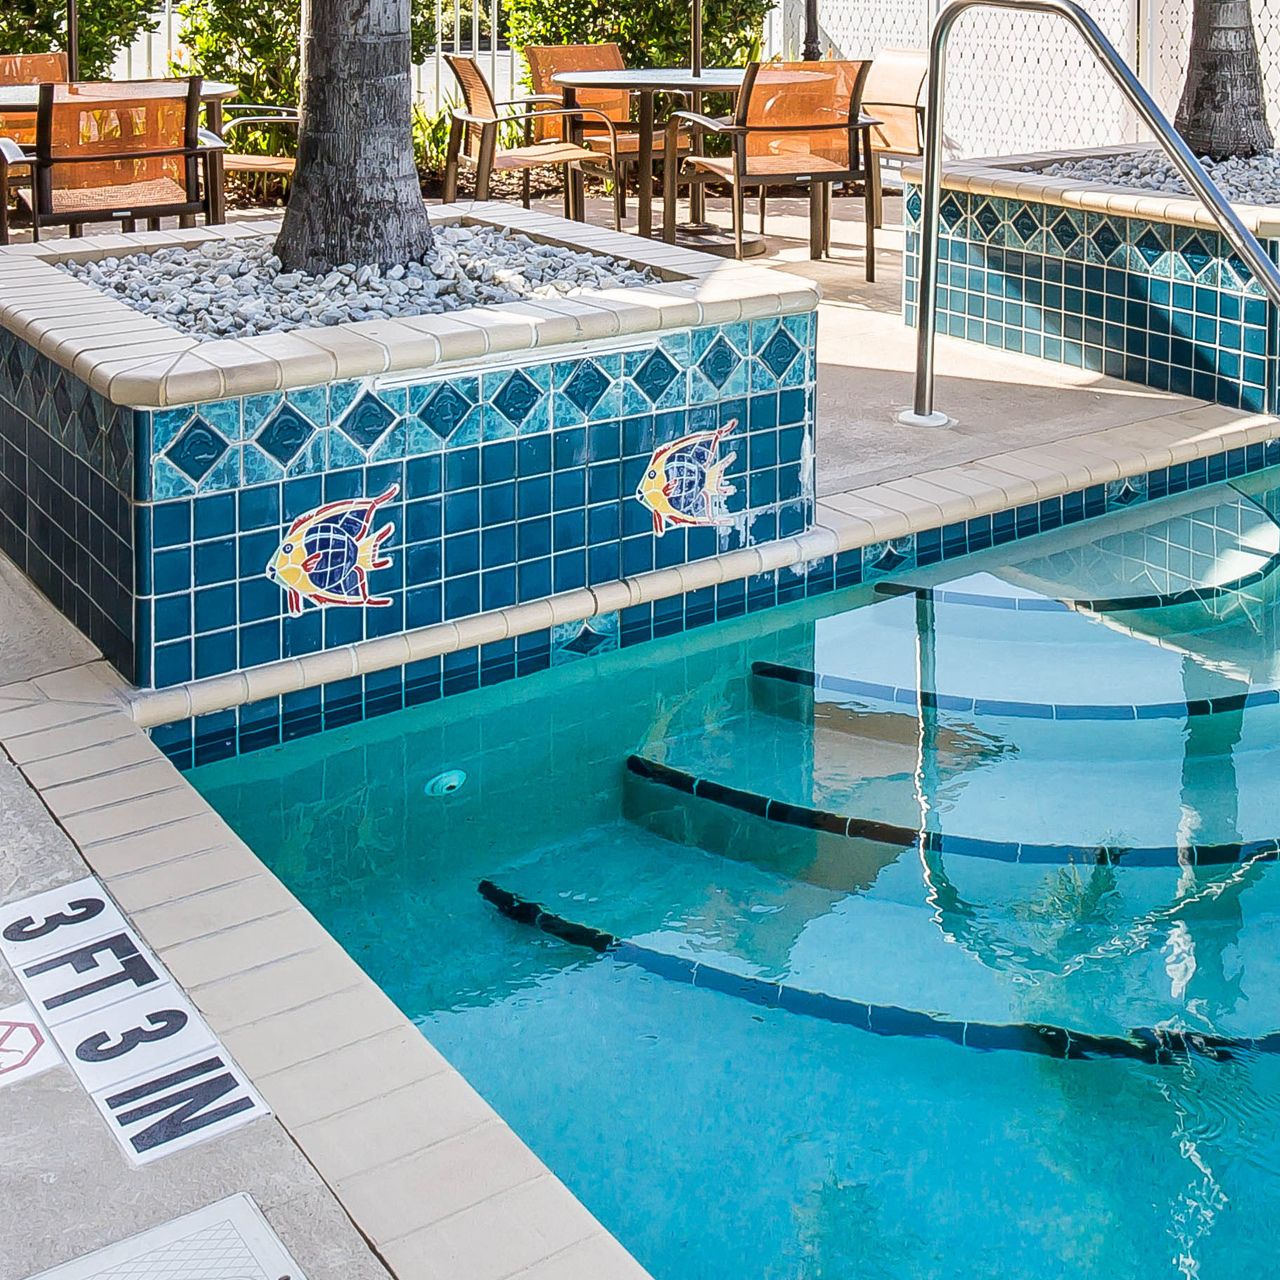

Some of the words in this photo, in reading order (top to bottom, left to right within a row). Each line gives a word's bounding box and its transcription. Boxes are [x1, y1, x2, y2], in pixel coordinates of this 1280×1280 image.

[2, 898, 106, 942] 3
[24, 932, 160, 1010] FT
[75, 1009, 188, 1062] 3
[104, 1056, 257, 1154] IN
